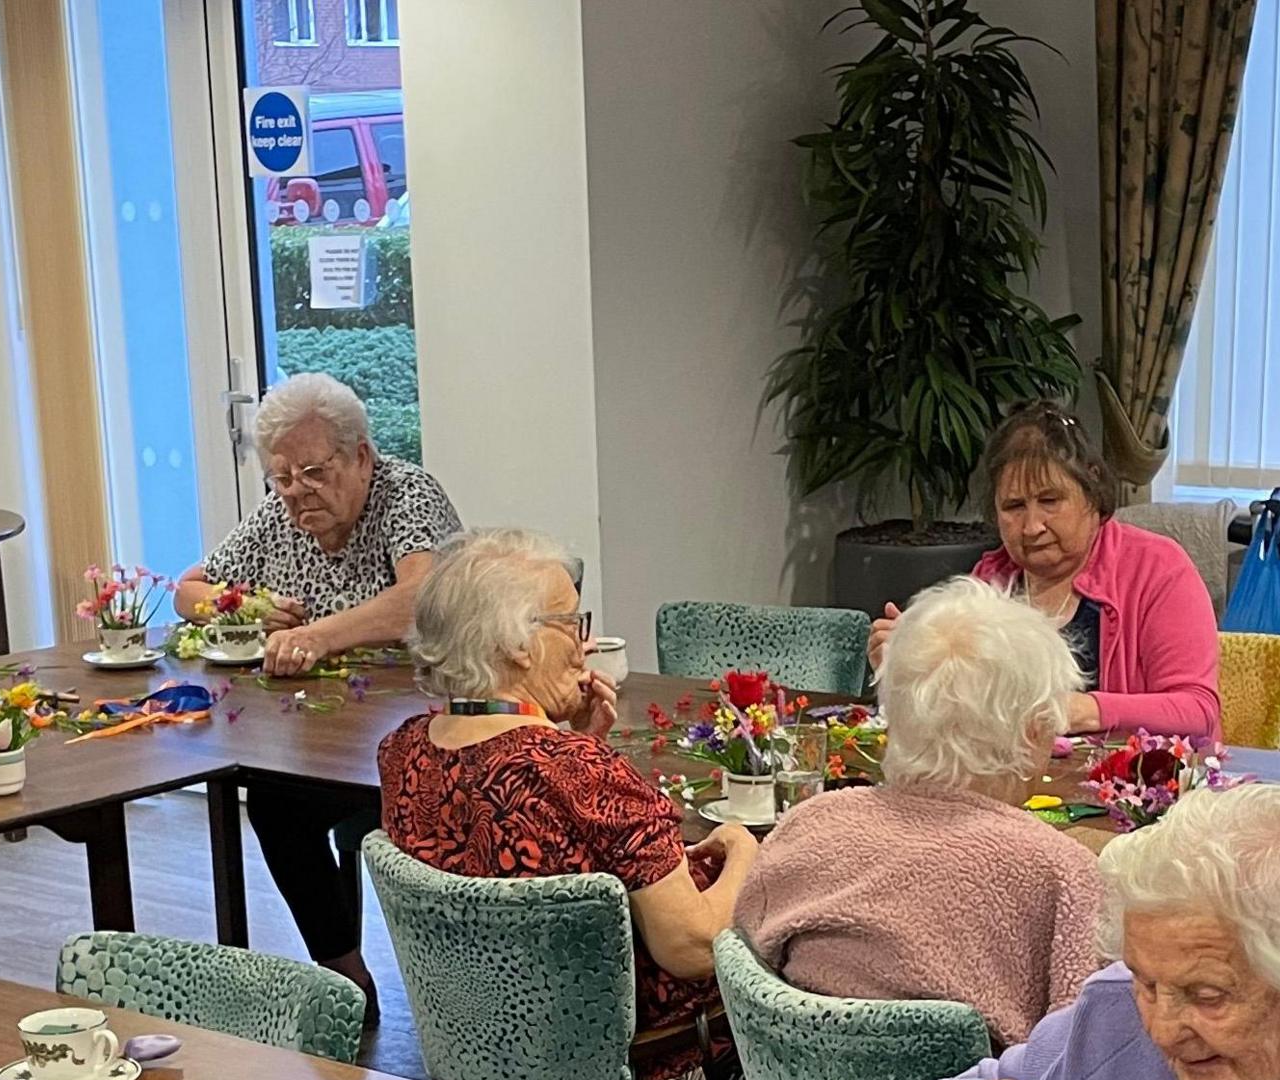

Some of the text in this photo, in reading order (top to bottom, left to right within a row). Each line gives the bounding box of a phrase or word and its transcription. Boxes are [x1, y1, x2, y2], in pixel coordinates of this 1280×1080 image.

[255, 115, 297, 129] Fire exit
[251, 134, 303, 150] keep clear
